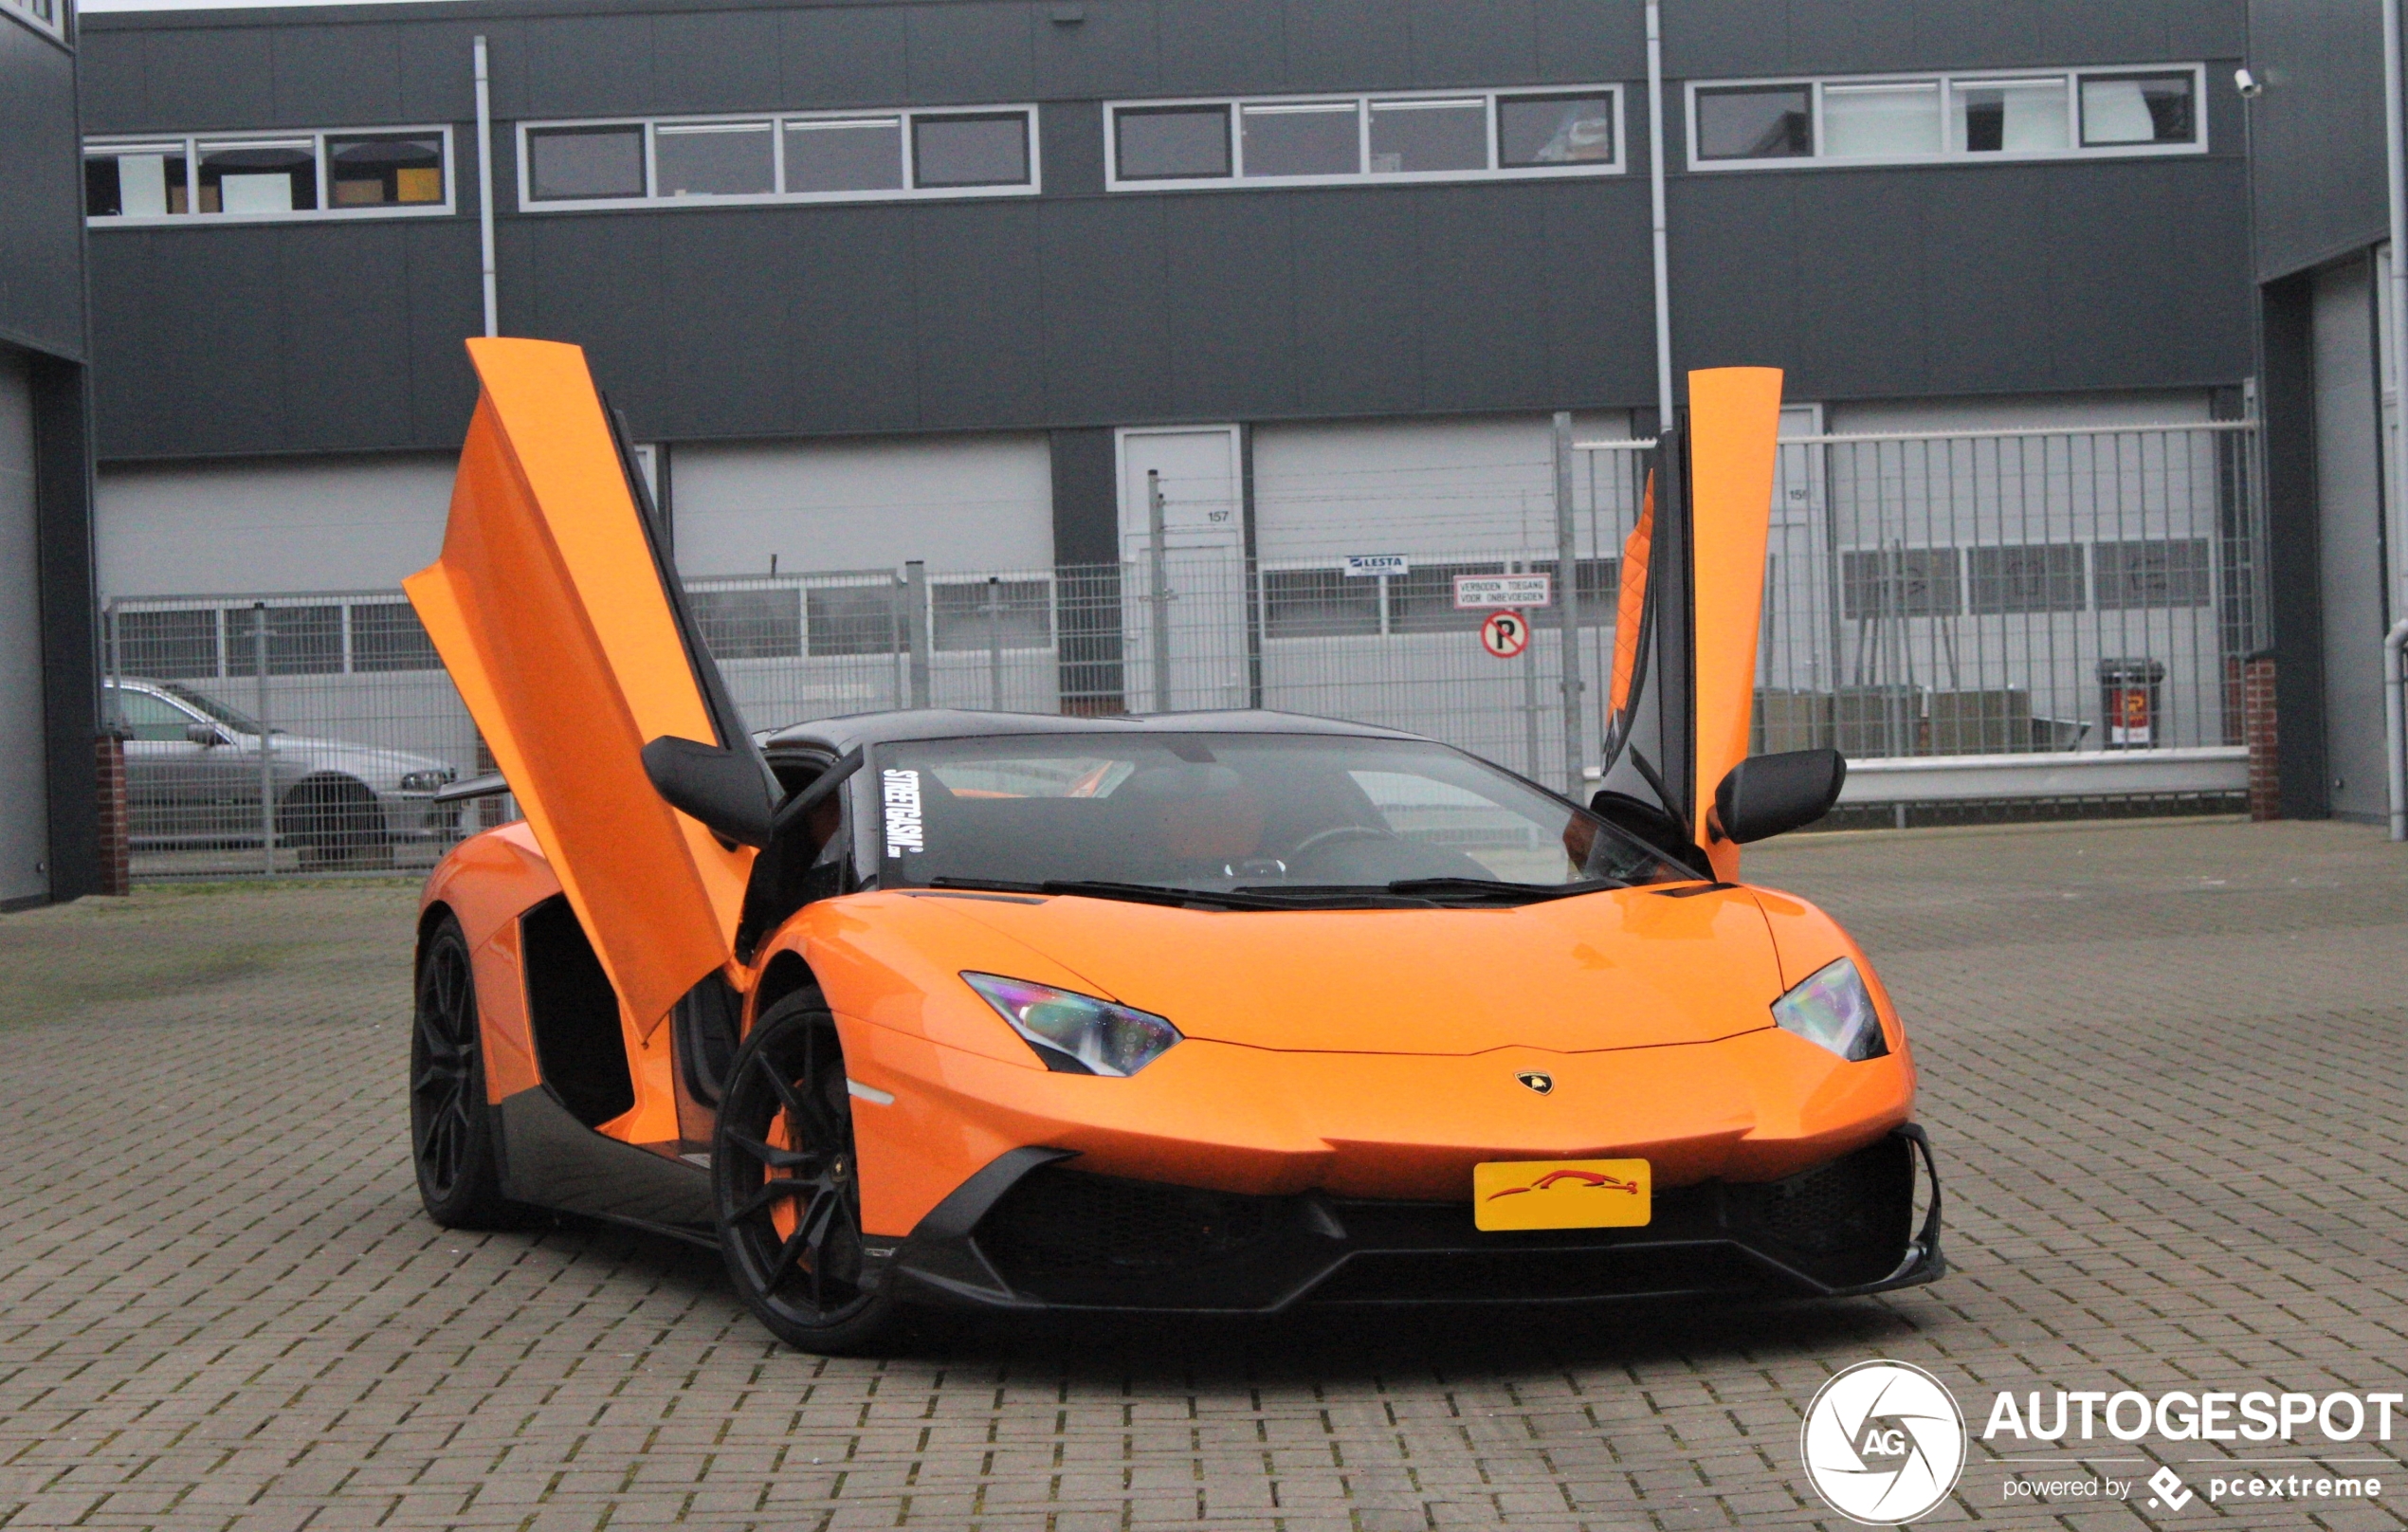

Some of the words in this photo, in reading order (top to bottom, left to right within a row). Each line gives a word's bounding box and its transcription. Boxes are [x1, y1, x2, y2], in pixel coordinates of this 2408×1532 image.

[1208, 510, 1229, 522] 157
[1364, 557, 1403, 567] LESTA
[1460, 581, 1502, 593] VERBODEN
[1507, 580, 1545, 592] TOEGANG
[1460, 593, 1482, 604] VOOR
[1487, 592, 1545, 603] ONBEVOEGDEN
[1496, 619, 1515, 649] P
